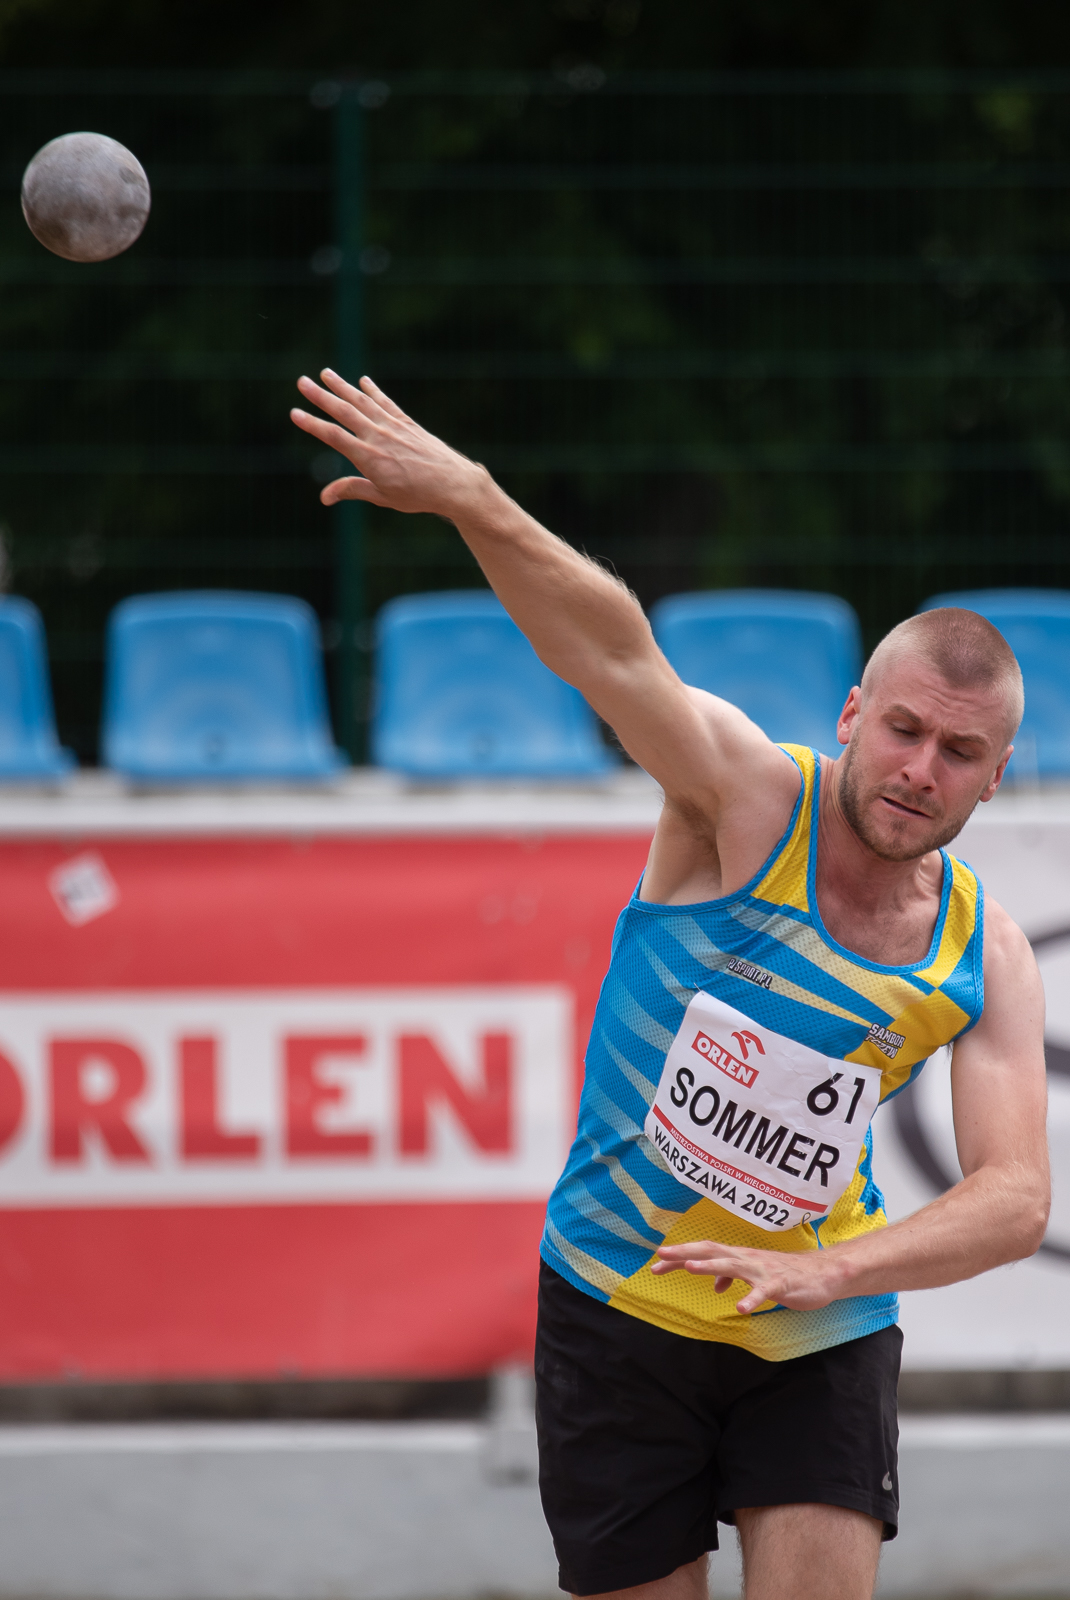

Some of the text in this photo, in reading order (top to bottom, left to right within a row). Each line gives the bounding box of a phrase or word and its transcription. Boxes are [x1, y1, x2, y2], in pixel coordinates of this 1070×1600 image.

[696, 1036, 754, 1085] ORLEN
[868, 1023, 906, 1049] SAMBOR
[0, 1030, 517, 1168] RLEN
[670, 1067, 840, 1187] SOMMER
[806, 1072, 866, 1125] 61
[653, 1125, 790, 1227] WARSZAWA 2022
[670, 1128, 796, 1206] MISTRZOSTWA POLSKI W WIELOBOJACH
